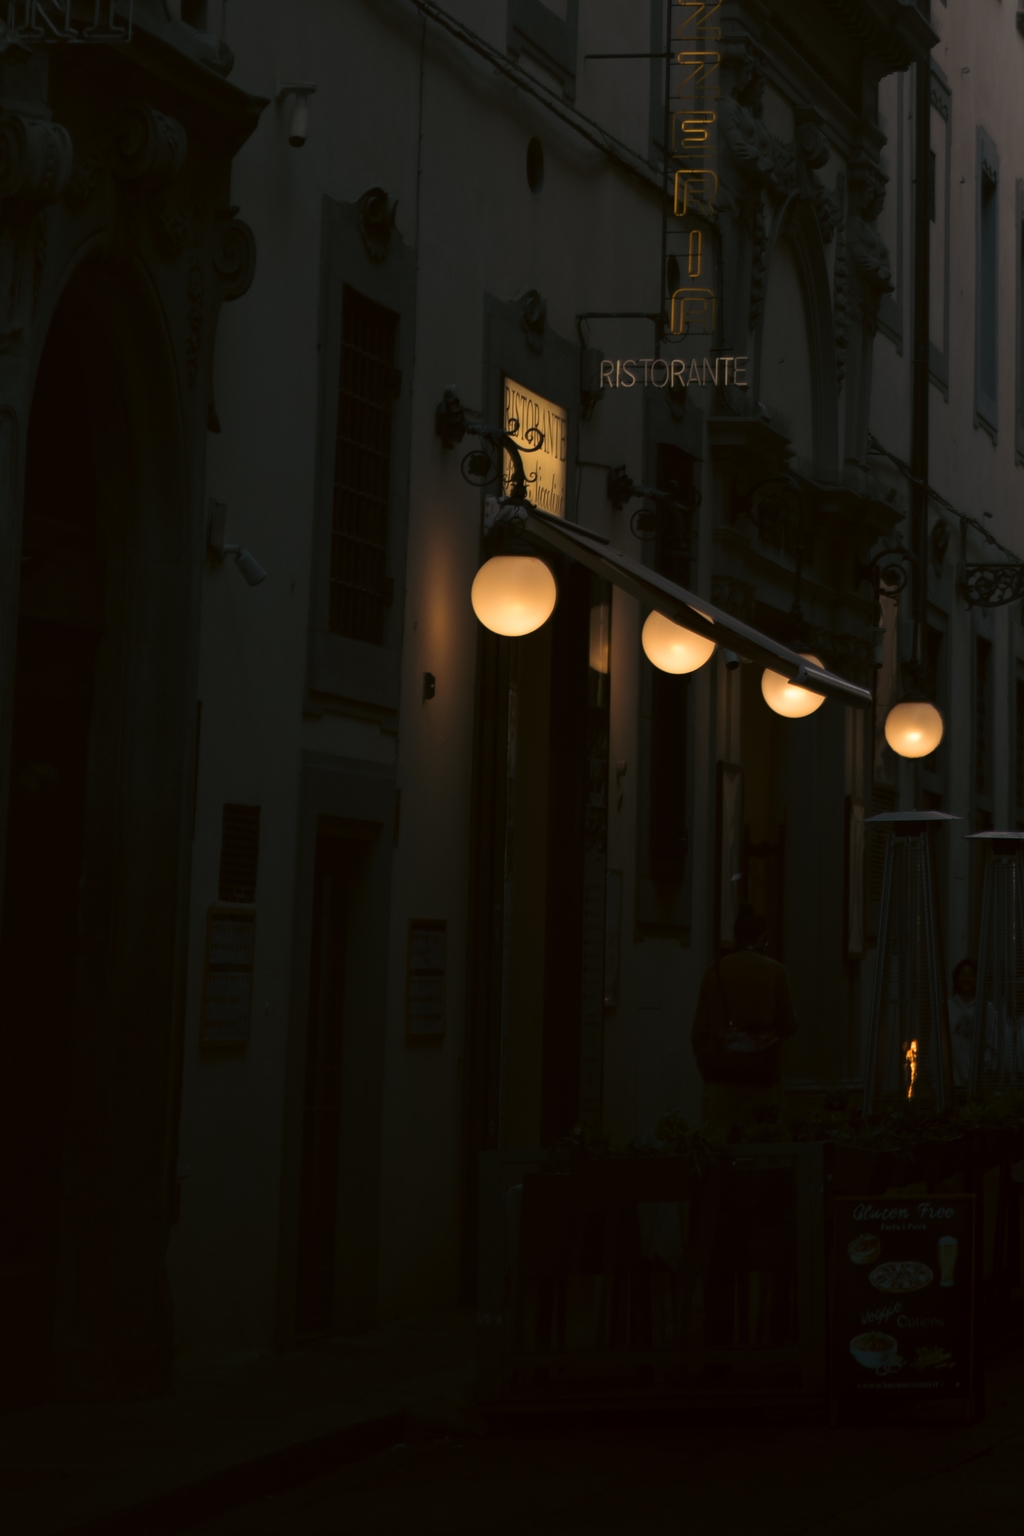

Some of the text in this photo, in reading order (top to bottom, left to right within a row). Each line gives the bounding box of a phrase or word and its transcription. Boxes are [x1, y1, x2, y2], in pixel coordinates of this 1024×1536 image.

[600, 356, 749, 389] RISTORANTE
[505, 385, 566, 463] RISTORANTE
[853, 1202, 955, 1221] Gluten Free
[880, 1223, 901, 1231] Pasta
[907, 1222, 927, 1231] Pizza
[861, 1302, 903, 1325] Veggie
[897, 1314, 945, 1329] Options
